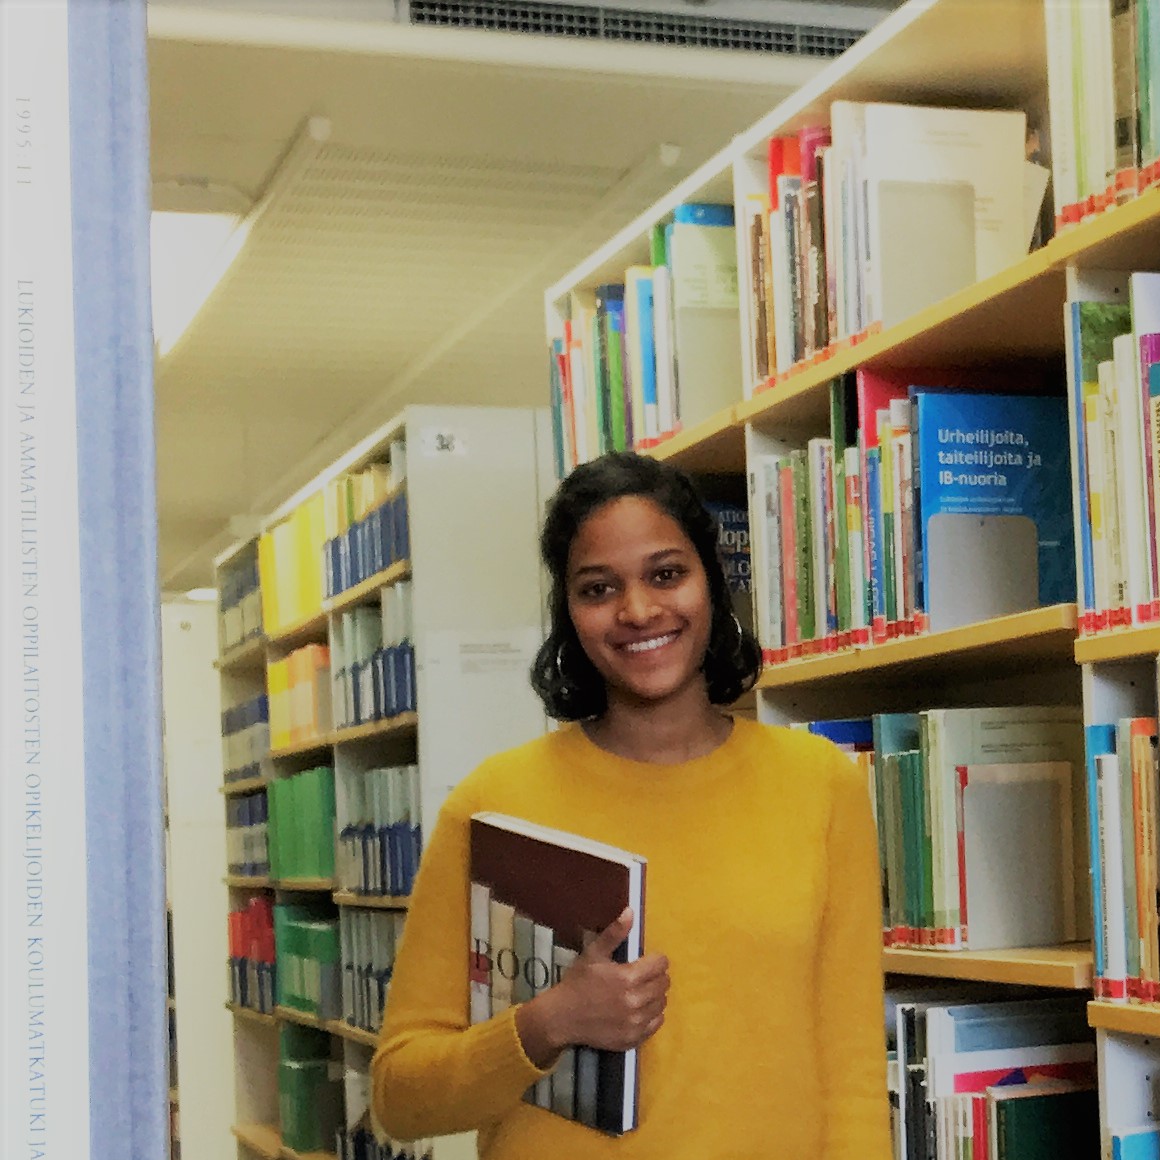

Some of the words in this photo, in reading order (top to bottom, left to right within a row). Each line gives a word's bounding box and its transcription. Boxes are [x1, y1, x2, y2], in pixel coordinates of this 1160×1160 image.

[17, 280, 36, 396] LUKIOIDEN
[16, 404, 36, 423] JA
[938, 428, 1029, 448] Urheilijoita,
[938, 449, 1023, 468] taiteilijoita
[1026, 451, 1042, 468] ja
[938, 470, 1007, 486] IB-nuoria
[19, 432, 38, 598] AMMATILLISTEN
[22, 606, 41, 764] OPPILAITOSTEN
[27, 937, 46, 1132] KOULUMATKATUKI
[26, 1140, 46, 1160] JA
